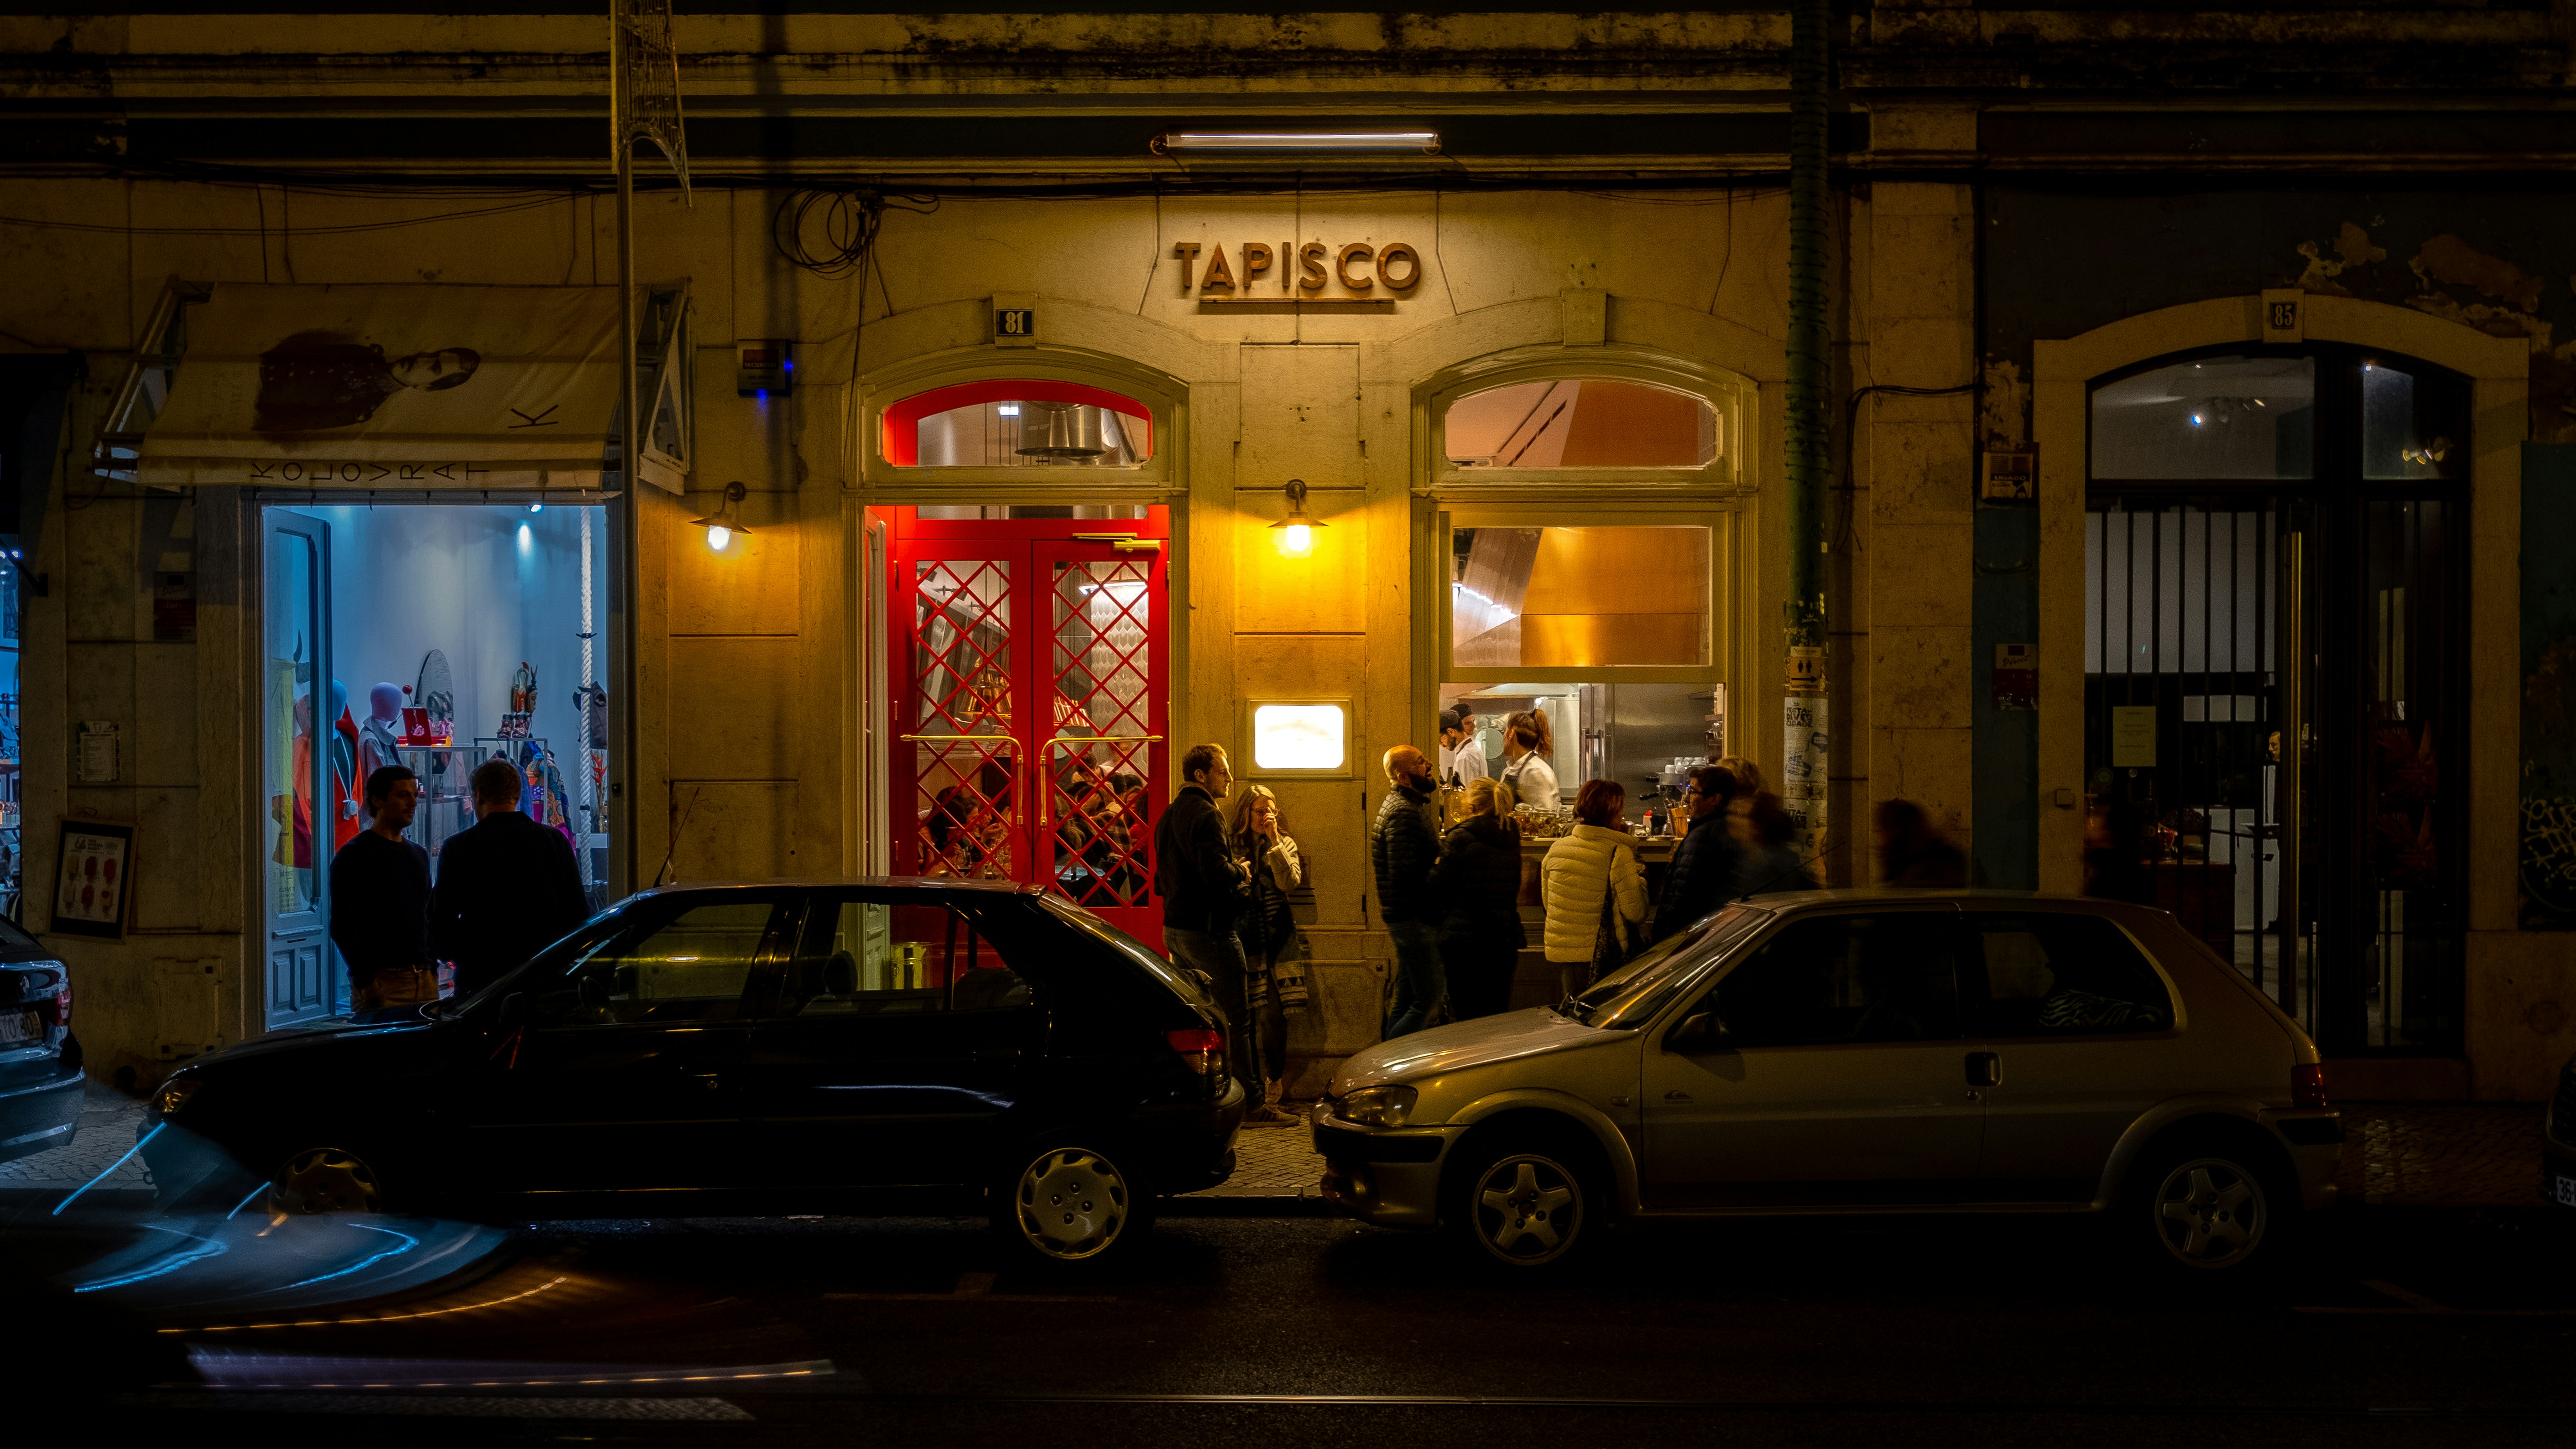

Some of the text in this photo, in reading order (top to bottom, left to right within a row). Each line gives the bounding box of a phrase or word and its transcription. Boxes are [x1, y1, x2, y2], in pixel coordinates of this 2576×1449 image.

[1174, 241, 1421, 290] TAPISCO
[1005, 312, 1024, 334] 81
[2274, 305, 2293, 326] 85
[508, 404, 559, 429] K
[250, 462, 490, 482] KOLOVRAT
